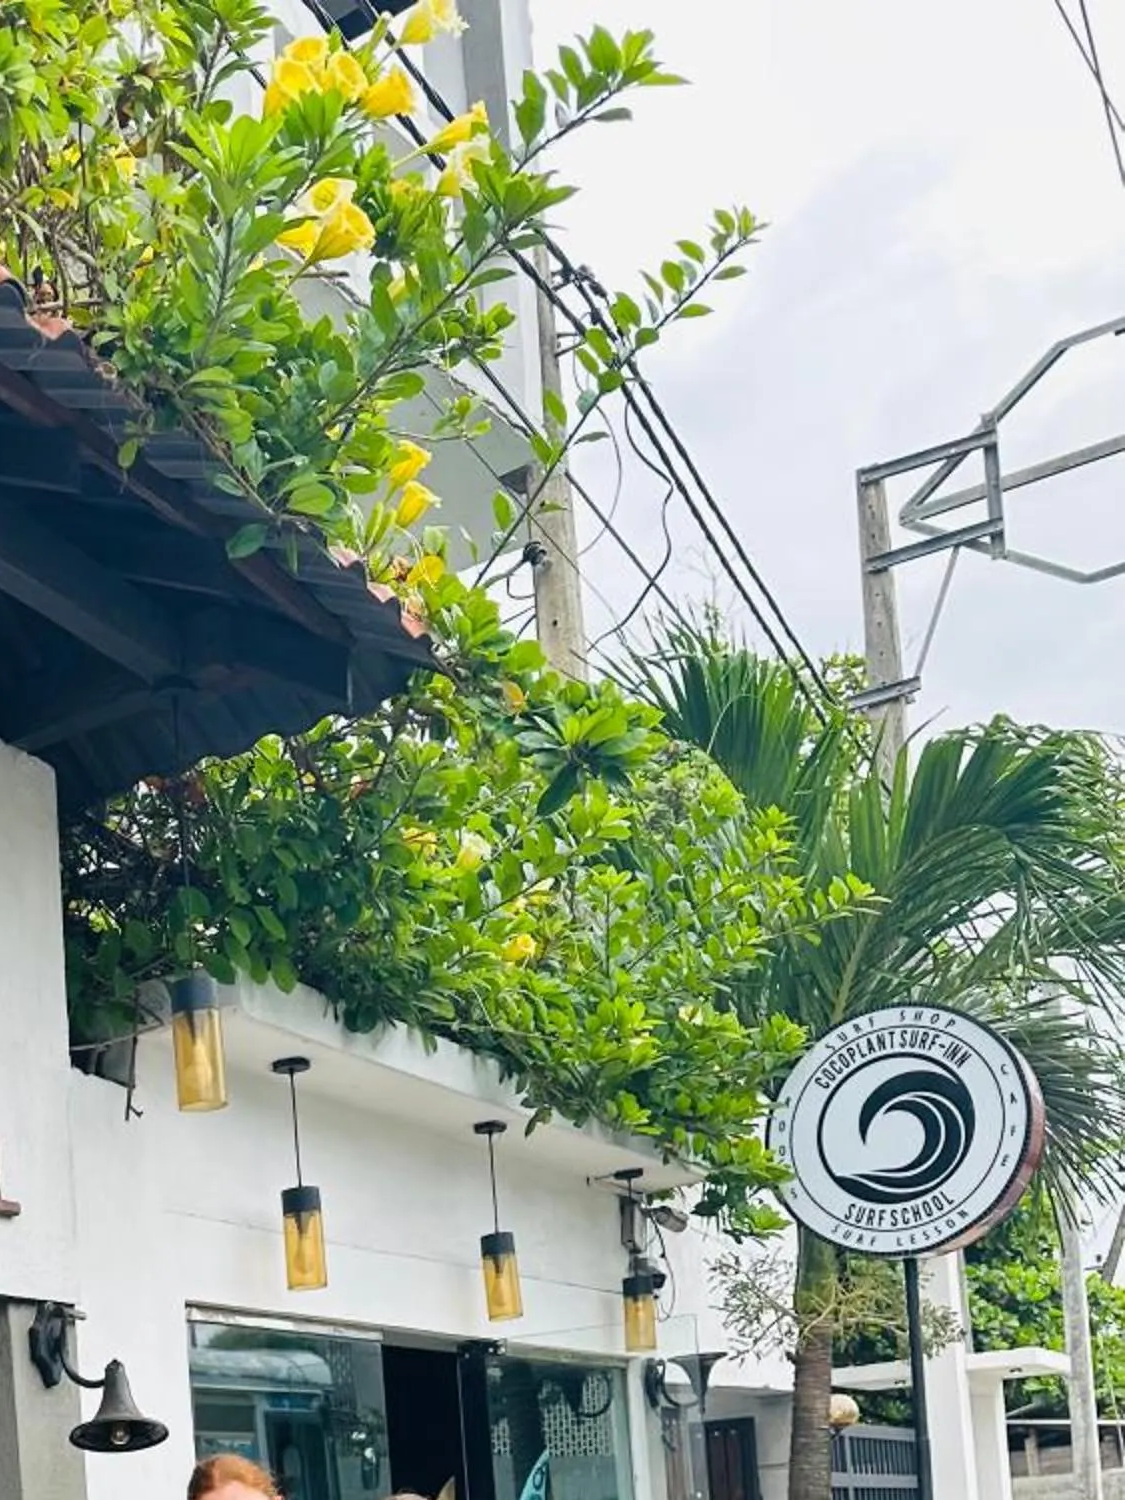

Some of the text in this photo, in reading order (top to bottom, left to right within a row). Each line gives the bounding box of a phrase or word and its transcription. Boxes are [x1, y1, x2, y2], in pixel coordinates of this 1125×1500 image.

[825, 1009, 957, 1051] SURF SHOP
[831, 1209, 970, 1247] SURF LESSON
